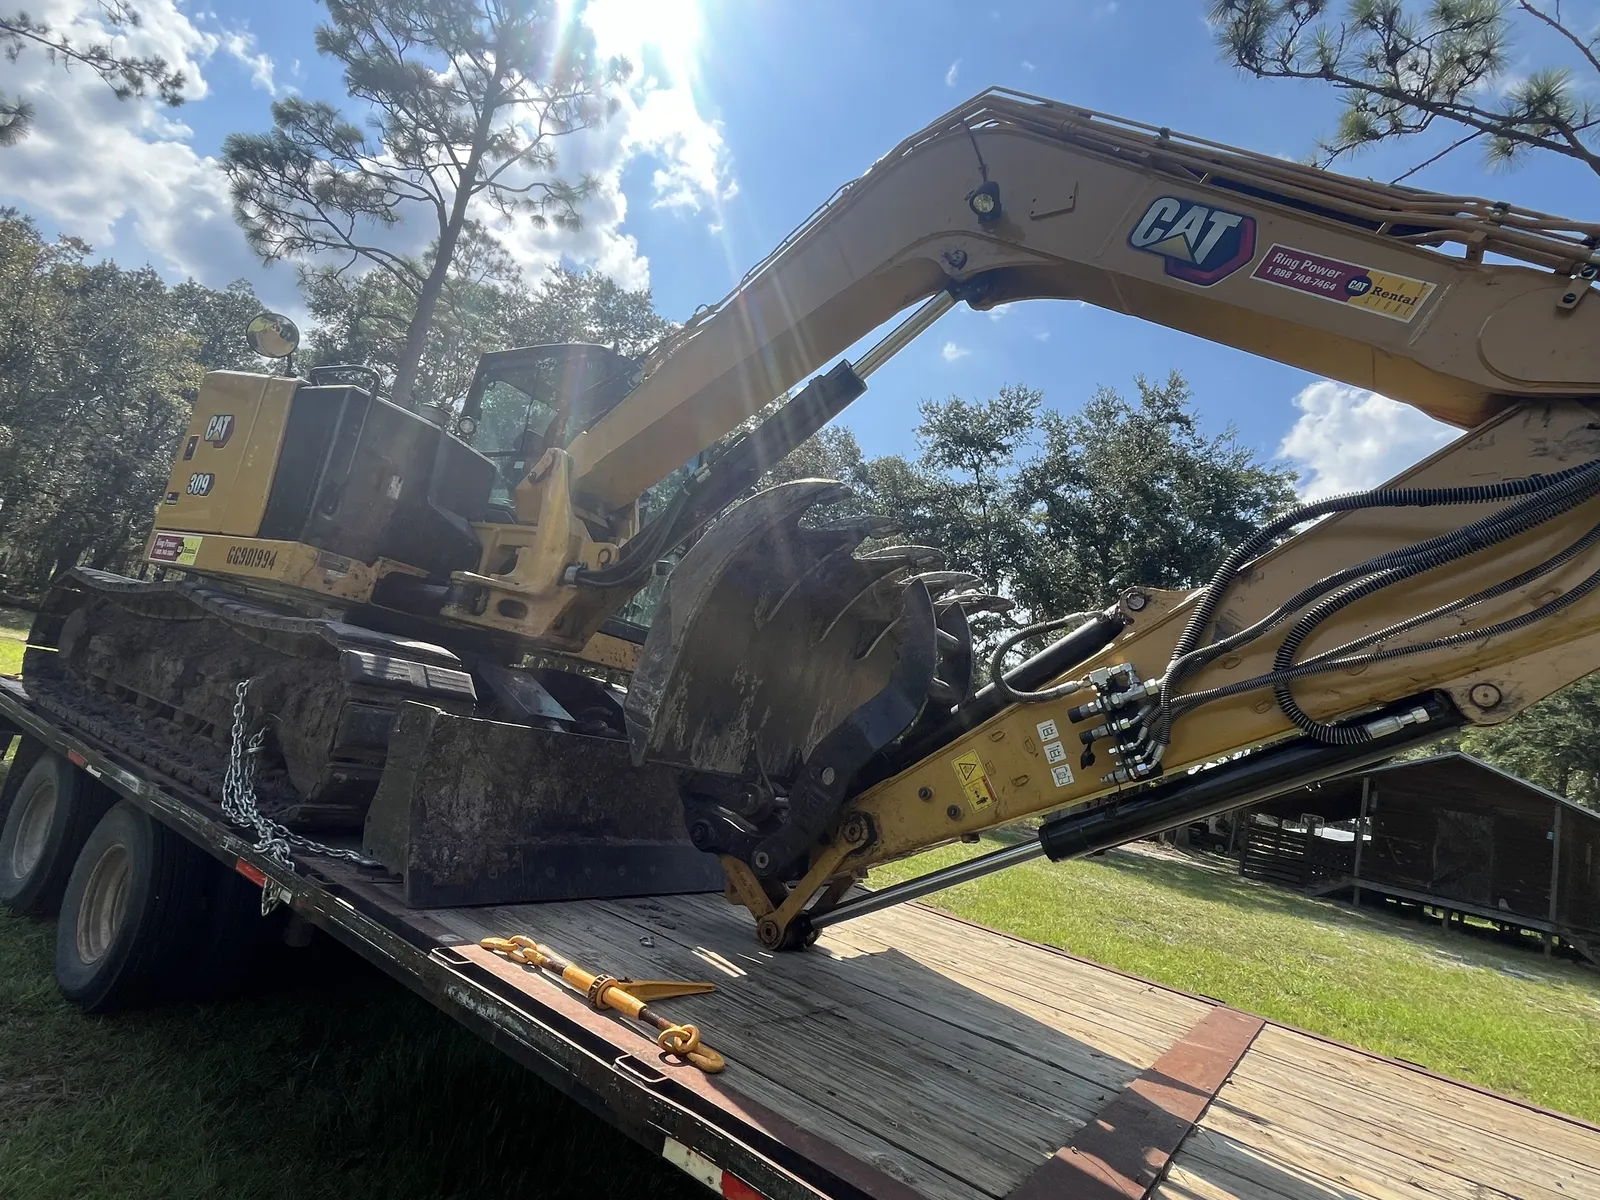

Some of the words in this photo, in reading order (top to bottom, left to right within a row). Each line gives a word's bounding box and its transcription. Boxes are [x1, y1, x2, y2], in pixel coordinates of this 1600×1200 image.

[1131, 197, 1243, 265] CAT
[1272, 252, 1300, 270] Ring
[1300, 260, 1342, 279] Power
[1266, 266, 1273, 274] 1
[1273, 267, 1293, 279] 888
[1293, 273, 1337, 291] 748-7464
[1348, 280, 1369, 292] CAT
[1370, 286, 1419, 306] Rental
[205, 415, 232, 441] CAT
[187, 473, 210, 495] 309
